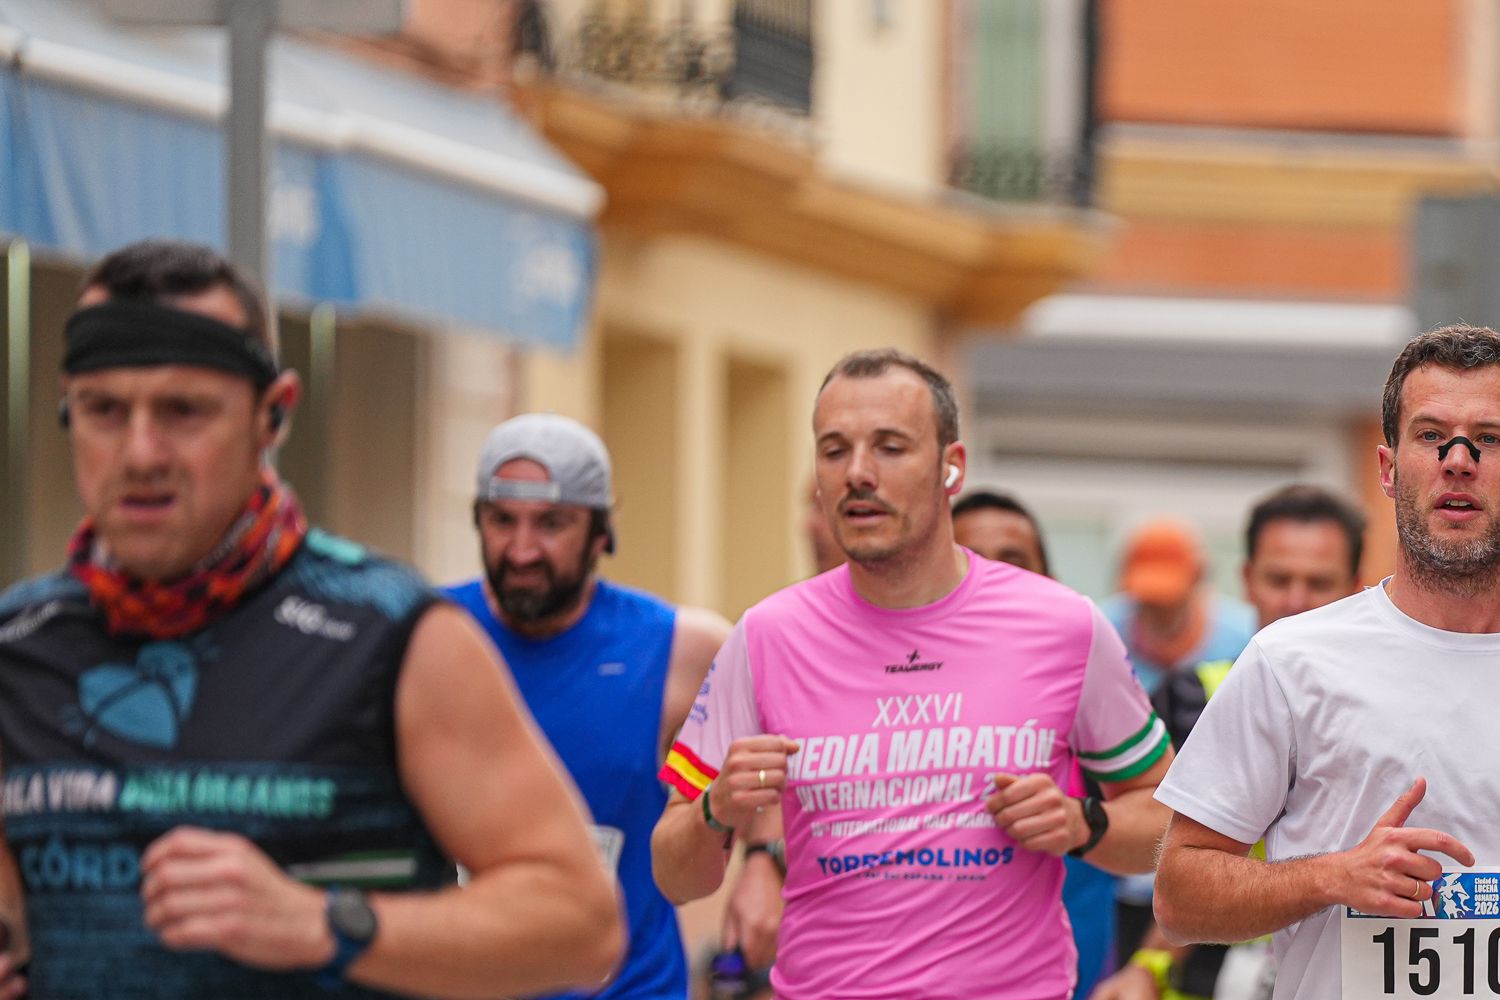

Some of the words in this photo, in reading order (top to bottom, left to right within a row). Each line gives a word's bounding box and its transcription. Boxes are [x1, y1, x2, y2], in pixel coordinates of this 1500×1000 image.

[872, 692, 963, 728] XXXVI
[787, 732, 879, 781] MEDIA
[886, 718, 1056, 773] MARATÓN
[795, 772, 974, 813] INTERNACIONAL
[20, 834, 141, 889] CÓRD
[817, 846, 1014, 875] TORREMOLINOS
[1475, 901, 1500, 915] 2026
